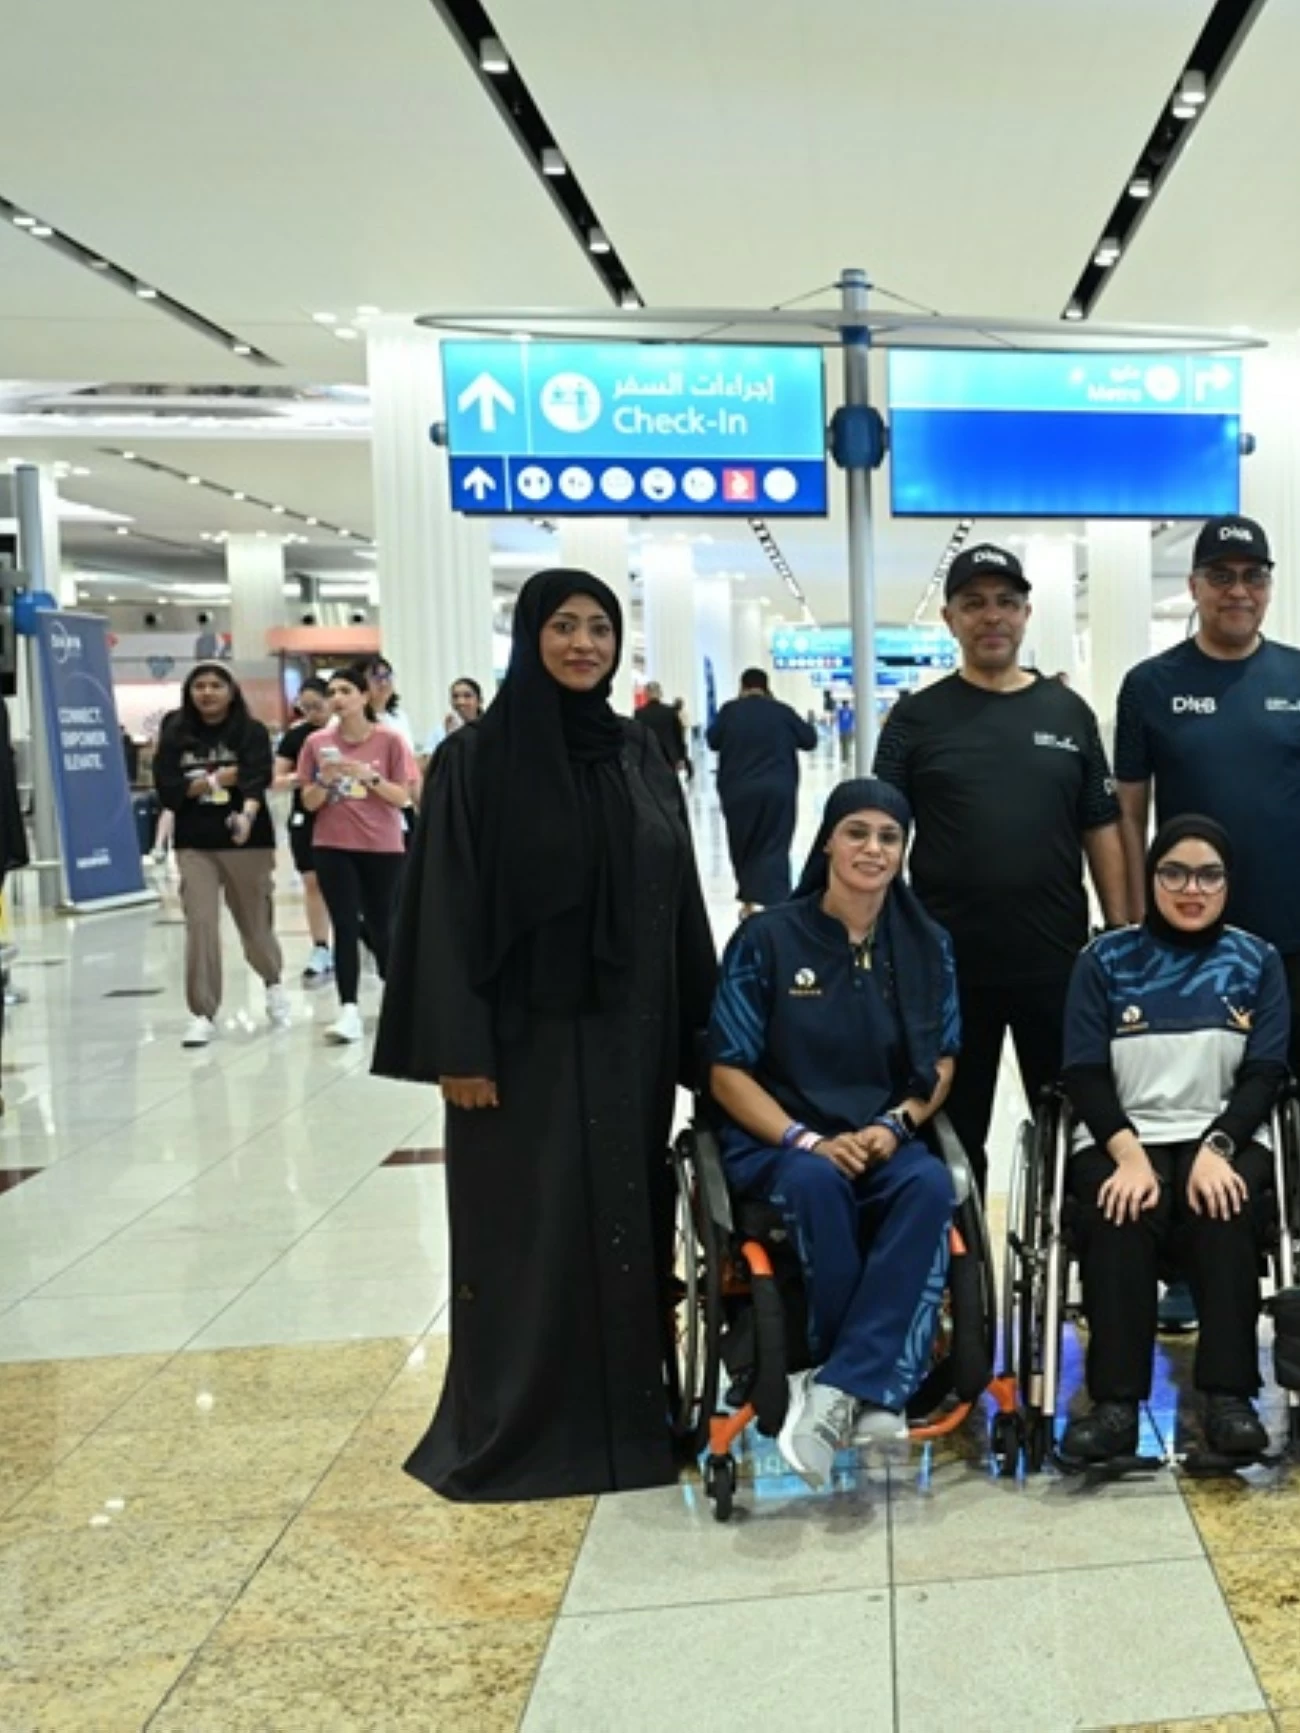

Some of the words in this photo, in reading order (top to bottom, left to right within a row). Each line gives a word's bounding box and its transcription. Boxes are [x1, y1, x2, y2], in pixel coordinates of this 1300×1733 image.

[612, 371, 684, 401] السفر
[690, 371, 775, 404] إجراءات
[611, 404, 748, 436] Check-In
